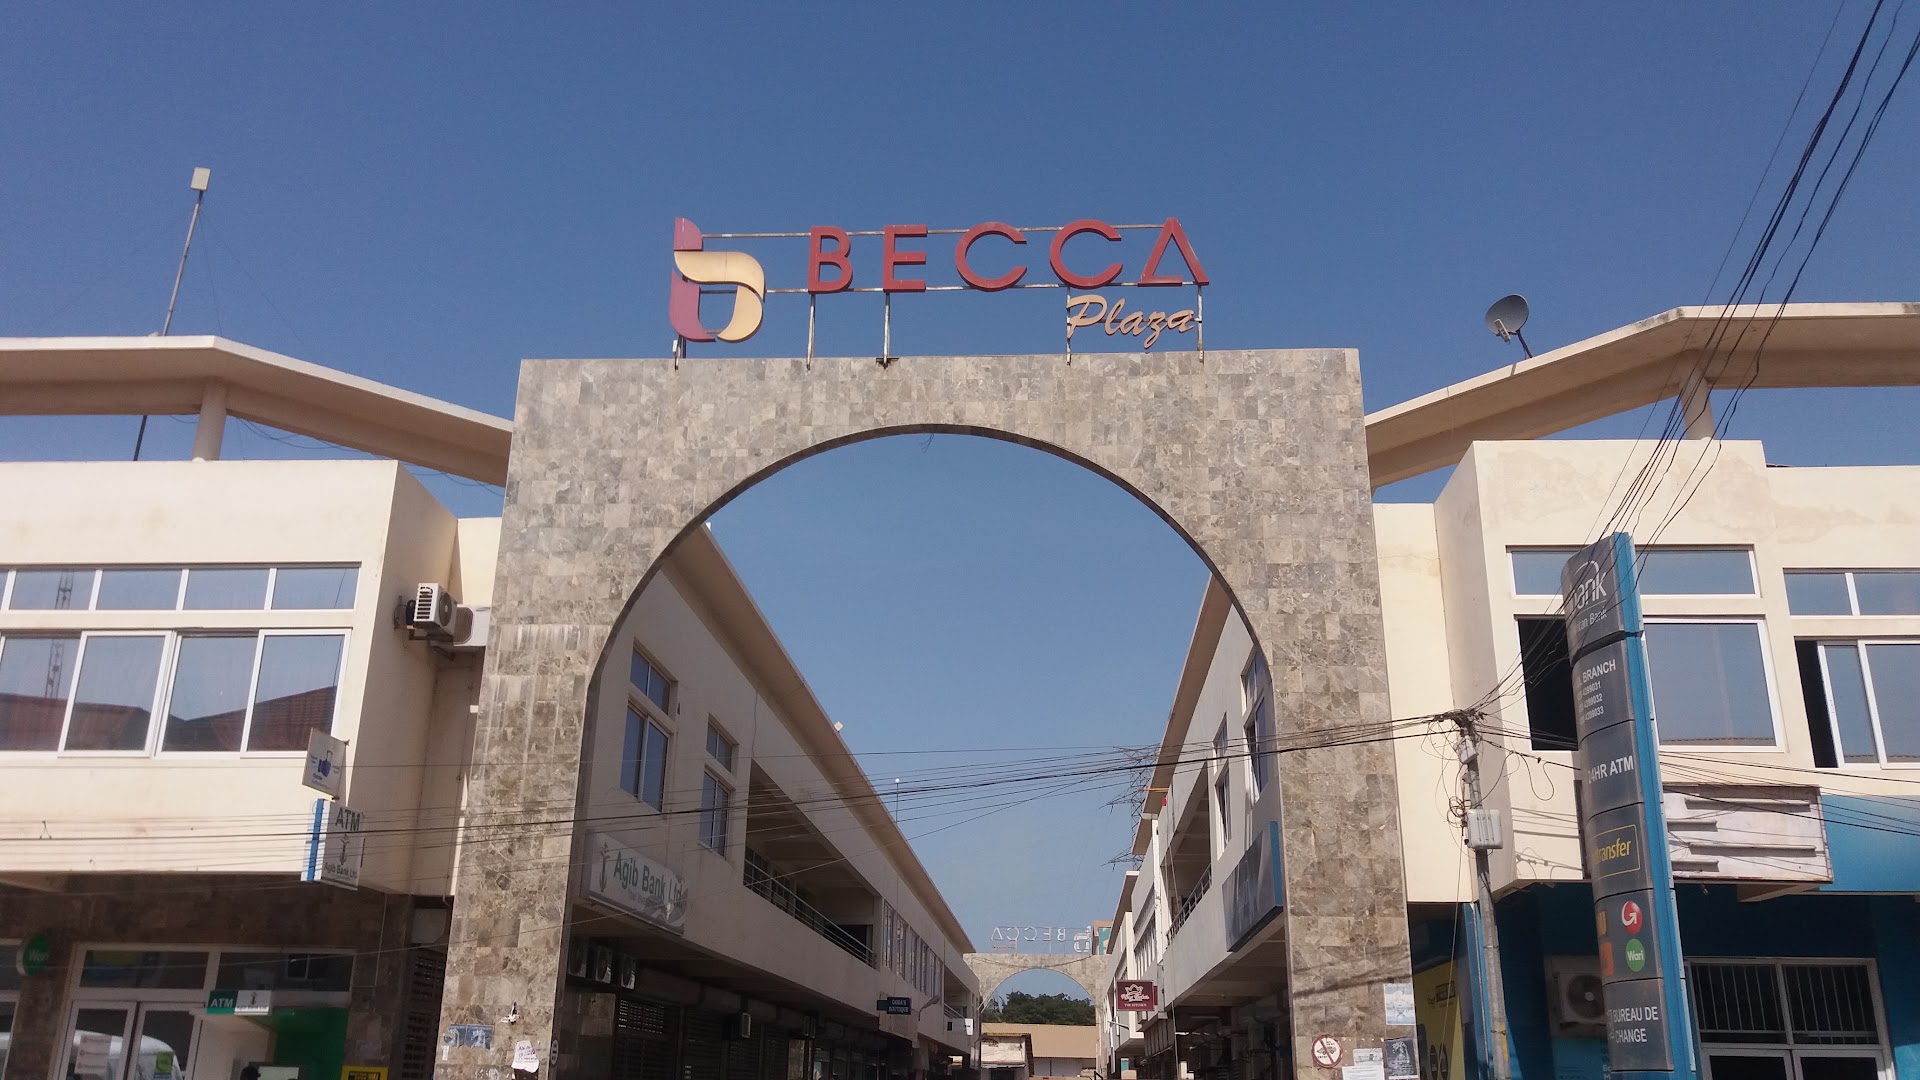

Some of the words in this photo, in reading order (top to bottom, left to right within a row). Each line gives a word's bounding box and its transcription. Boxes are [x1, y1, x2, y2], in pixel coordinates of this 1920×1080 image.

[808, 218, 1209, 294] BECCA
[1066, 294, 1197, 349] Plaza
[1582, 659, 1616, 683] BRANCH
[1610, 755, 1634, 776] ATM
[335, 807, 361, 831] ATM
[613, 850, 638, 889] Agib
[642, 865, 666, 900] Bank
[1627, 950, 1644, 961] Wari
[210, 998, 234, 1008] ATM
[1613, 1007, 1643, 1023] BUREAU
[1644, 1006, 1659, 1021] DE
[1615, 1028, 1647, 1043] CHANGE
